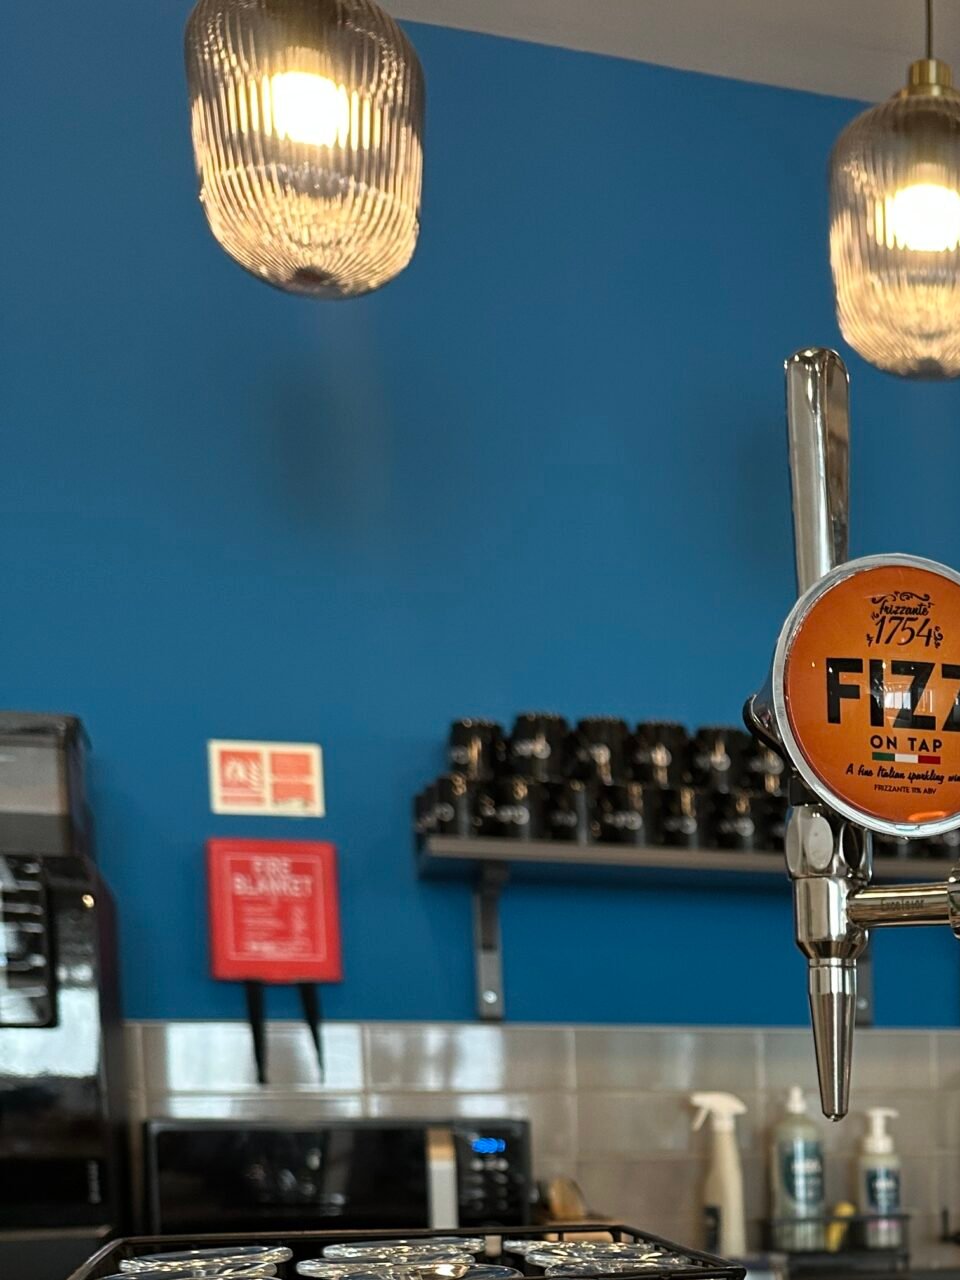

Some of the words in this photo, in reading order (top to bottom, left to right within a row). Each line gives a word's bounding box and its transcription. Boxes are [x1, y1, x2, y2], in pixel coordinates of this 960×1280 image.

[874, 616, 933, 647] 1754
[870, 735, 897, 750] ON
[908, 738, 943, 752] TAP
[846, 763, 854, 775] A
[858, 764, 873, 777] fine
[877, 765, 906, 780] Italian
[907, 768, 945, 785] sparkling
[874, 784, 910, 794] FRIZZANTE
[923, 786, 937, 795] ABV
[253, 857, 292, 874] FIRE
[233, 872, 313, 897] BLANKET
